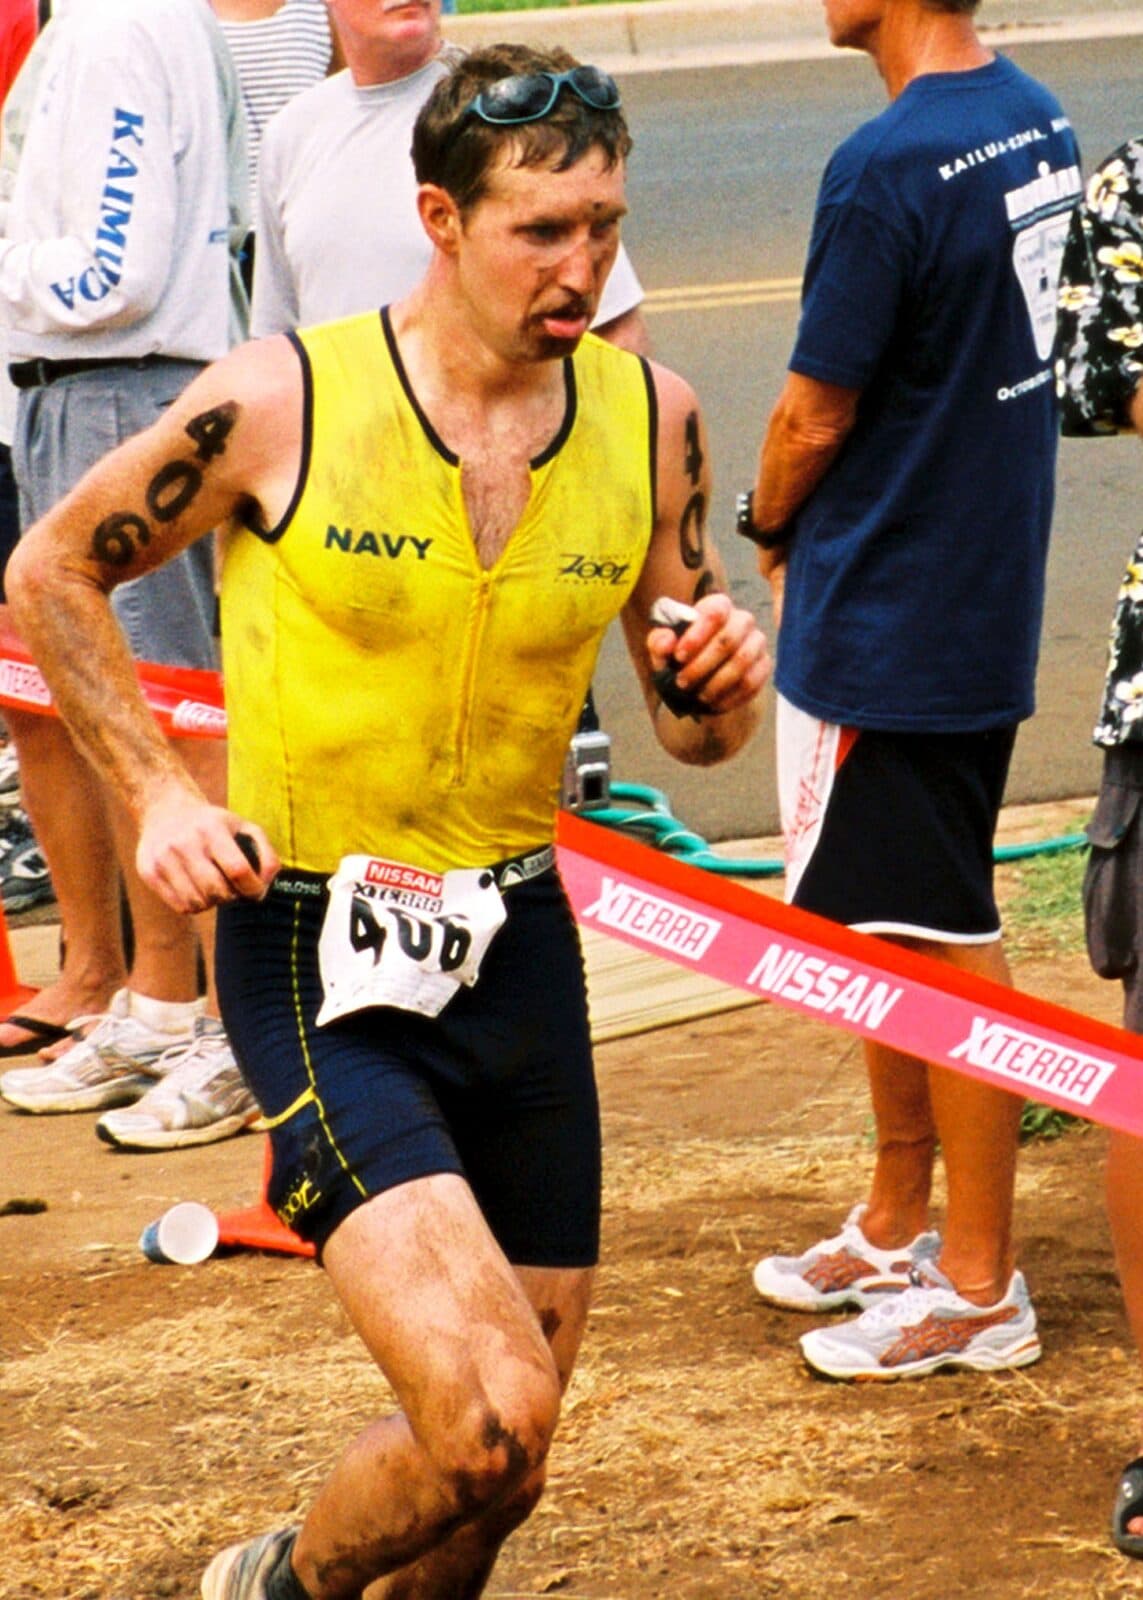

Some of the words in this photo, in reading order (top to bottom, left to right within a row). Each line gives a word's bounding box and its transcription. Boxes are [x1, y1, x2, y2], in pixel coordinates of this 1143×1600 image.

[92, 400, 240, 566] 406
[325, 525, 433, 559] NAVY
[368, 863, 442, 895] NISSAN
[582, 877, 721, 961] XTERRA
[747, 943, 904, 1031] NISSAN
[948, 1016, 1116, 1106] XTERRA
